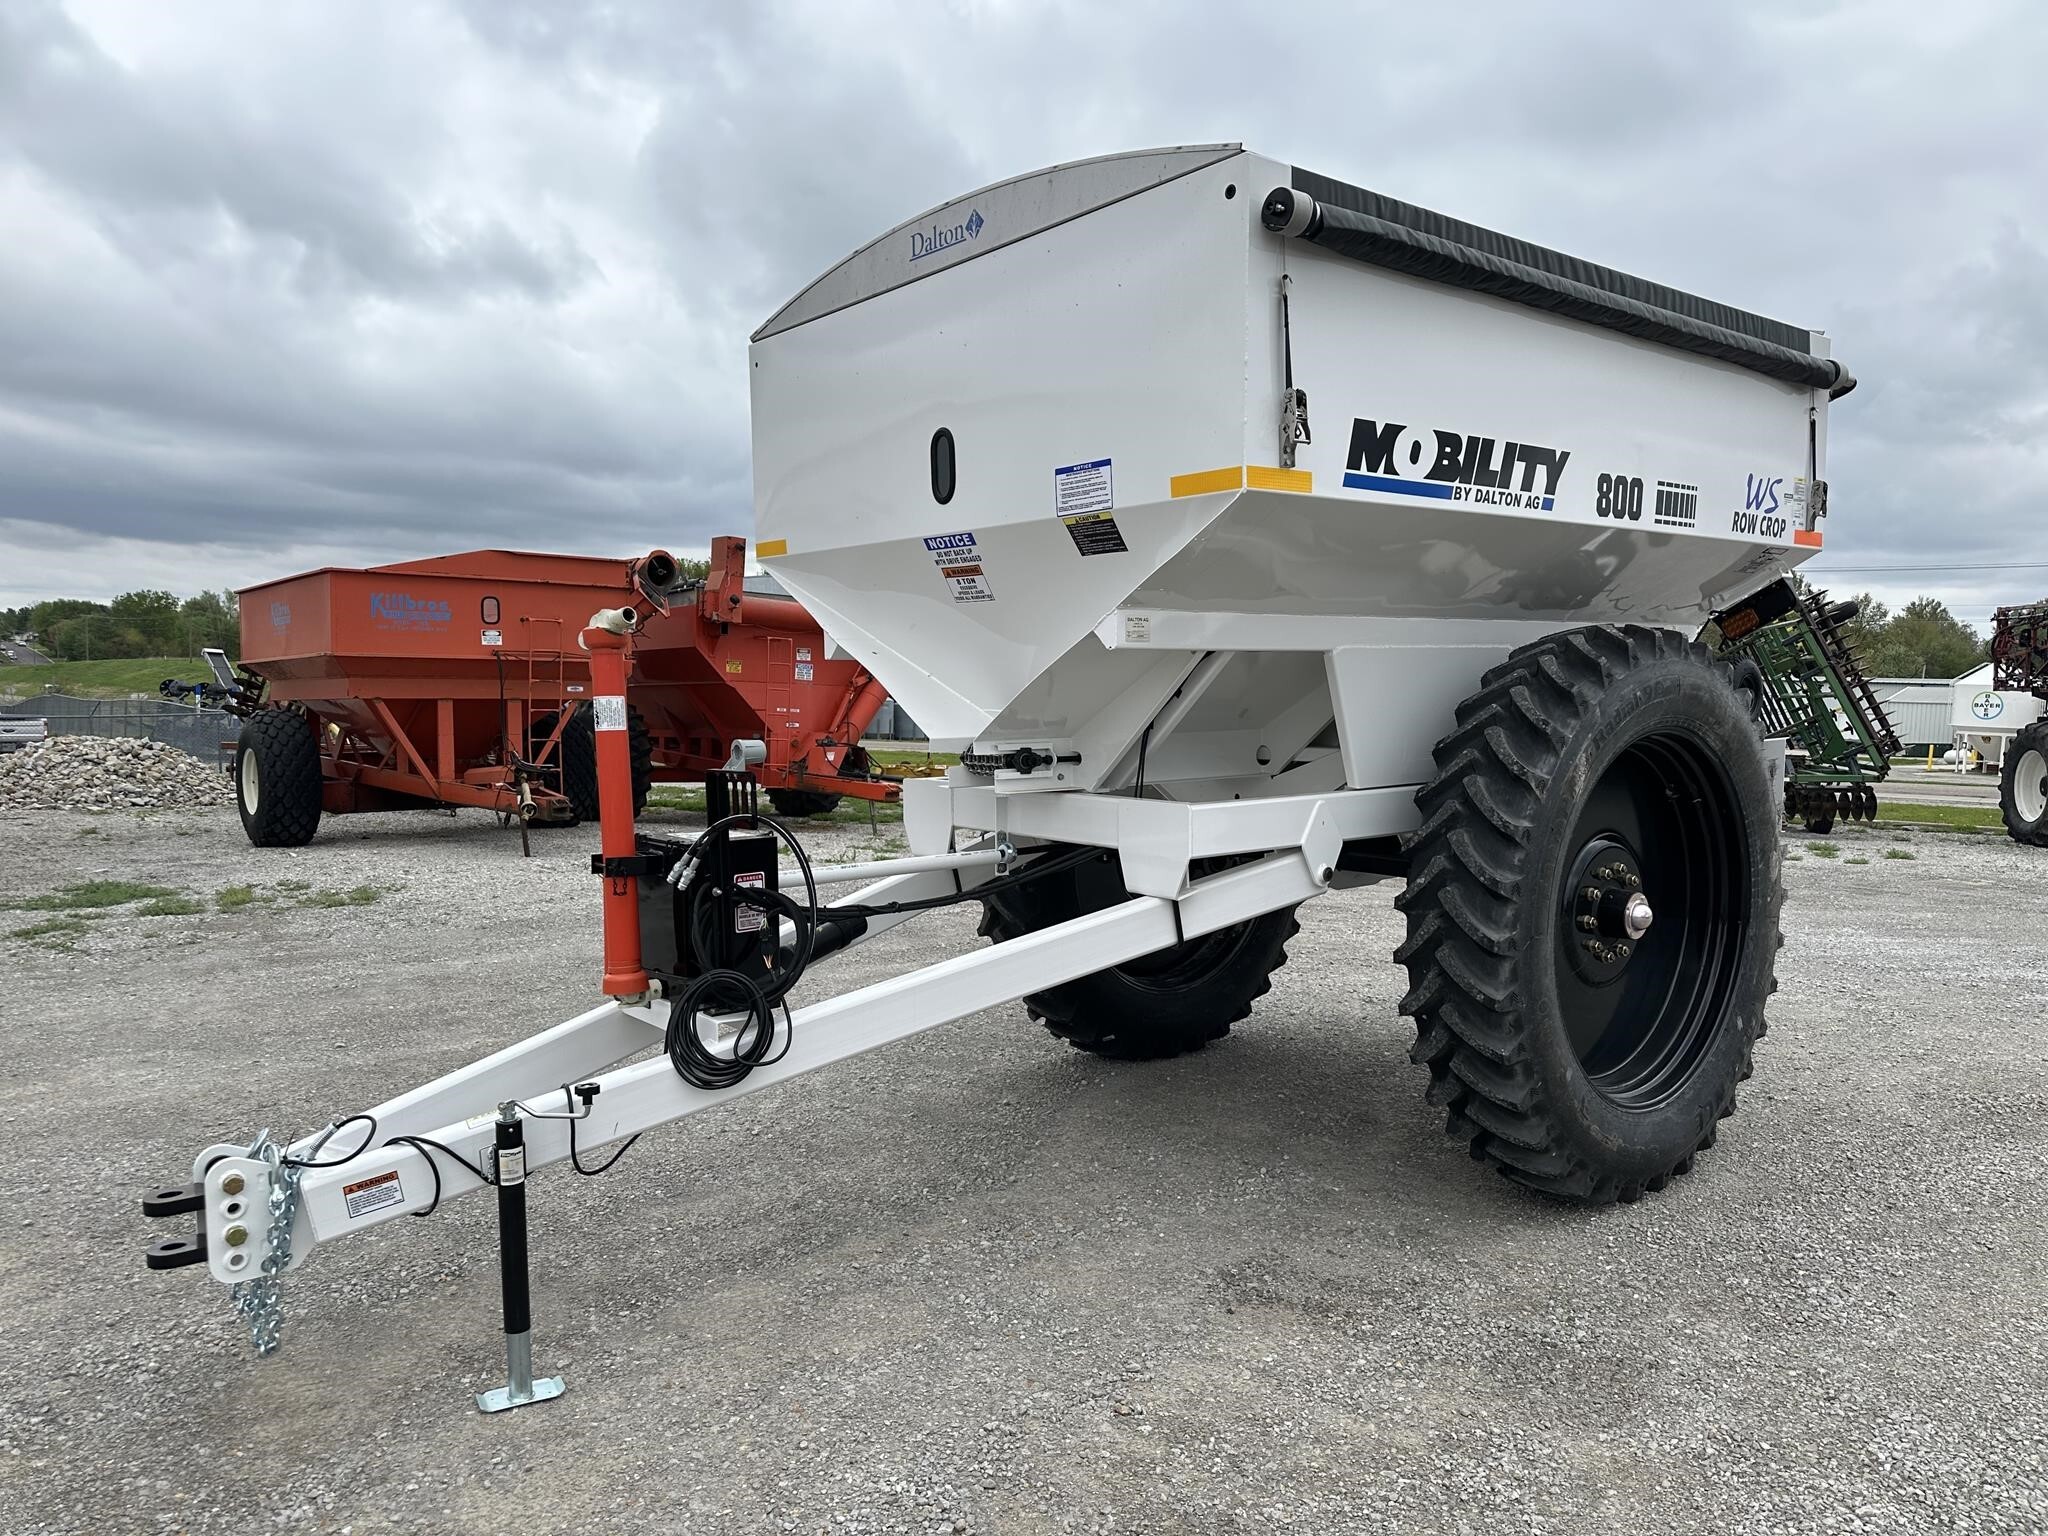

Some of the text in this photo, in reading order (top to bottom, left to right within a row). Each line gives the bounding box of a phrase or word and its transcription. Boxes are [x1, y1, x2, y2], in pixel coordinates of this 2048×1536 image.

[910, 224, 966, 258] Dalton
[1346, 417, 1571, 496] MOBILITY
[1073, 463, 1092, 471] NOTICE
[1453, 486, 1540, 510] BY DALTON AG
[1596, 473, 1644, 521] 800
[1746, 472, 1784, 514] WS
[1732, 511, 1787, 539] ROW CROP
[927, 534, 972, 549] NOTICE
[934, 554, 983, 566] WITH DRIVE ENGAGED
[943, 550, 954, 558] NOT
[953, 548, 967, 557] BACK
[966, 547, 973, 555] UP
[951, 567, 980, 575] WARNING
[961, 577, 977, 585] TON
[369, 592, 449, 619] Killbros
[356, 1173, 395, 1189] WARNING
